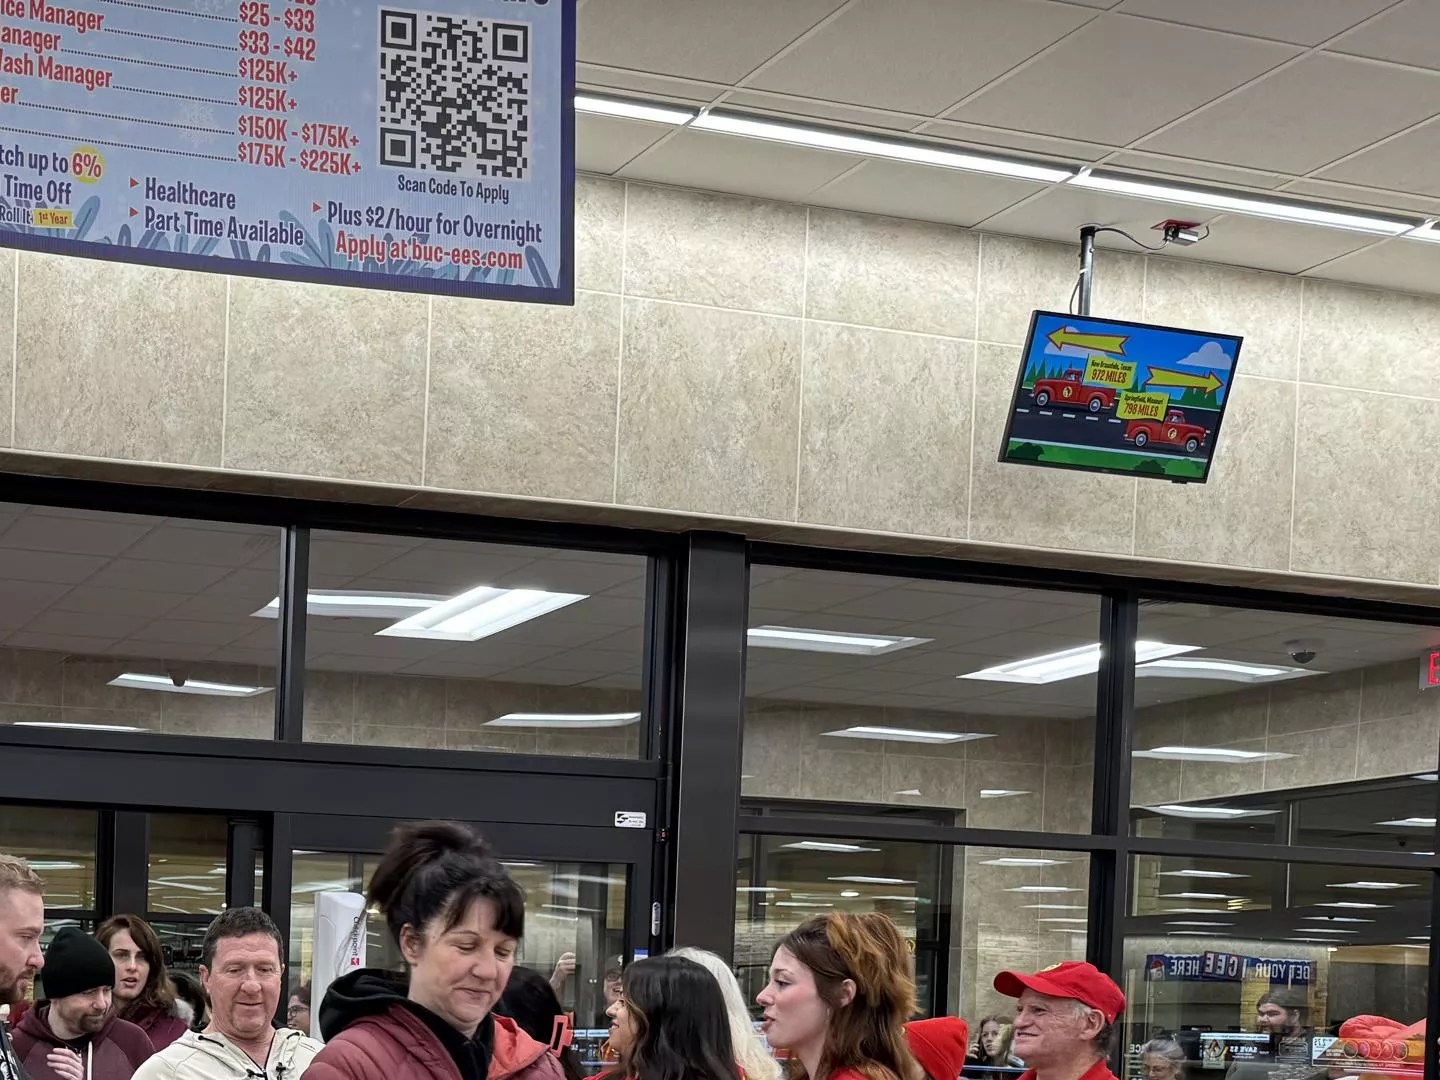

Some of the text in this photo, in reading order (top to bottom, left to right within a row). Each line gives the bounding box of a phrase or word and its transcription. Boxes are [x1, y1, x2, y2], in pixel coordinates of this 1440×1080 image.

[29, 0, 105, 33] Manager
[239, 1, 270, 28] $25
[284, 8, 315, 33] $33
[238, 30, 270, 57] $33
[284, 36, 316, 62] $42
[38, 55, 113, 90] Manager
[238, 57, 298, 85] $125K+
[238, 86, 297, 113] $125K+
[238, 115, 288, 142] $150K
[301, 123, 359, 150] $175K+
[28, 155, 48, 176] up
[52, 155, 69, 173] to
[72, 152, 102, 177] 6%
[237, 142, 286, 168] $175K
[300, 150, 361, 177] $225K+
[4, 173, 43, 201] Time
[46, 179, 72, 205] Off
[145, 177, 236, 209] Healthcare
[398, 175, 510, 205] Scan Code To Apply
[38, 212, 68, 226] 1st Year
[145, 206, 304, 246] Part Time Available
[328, 200, 543, 248] Plus $2/hour for Overnight
[336, 230, 523, 270] Apply at buc-ees.com
[1092, 369, 1127, 384] 972 MILES
[1124, 402, 1159, 417] 798 MILES
